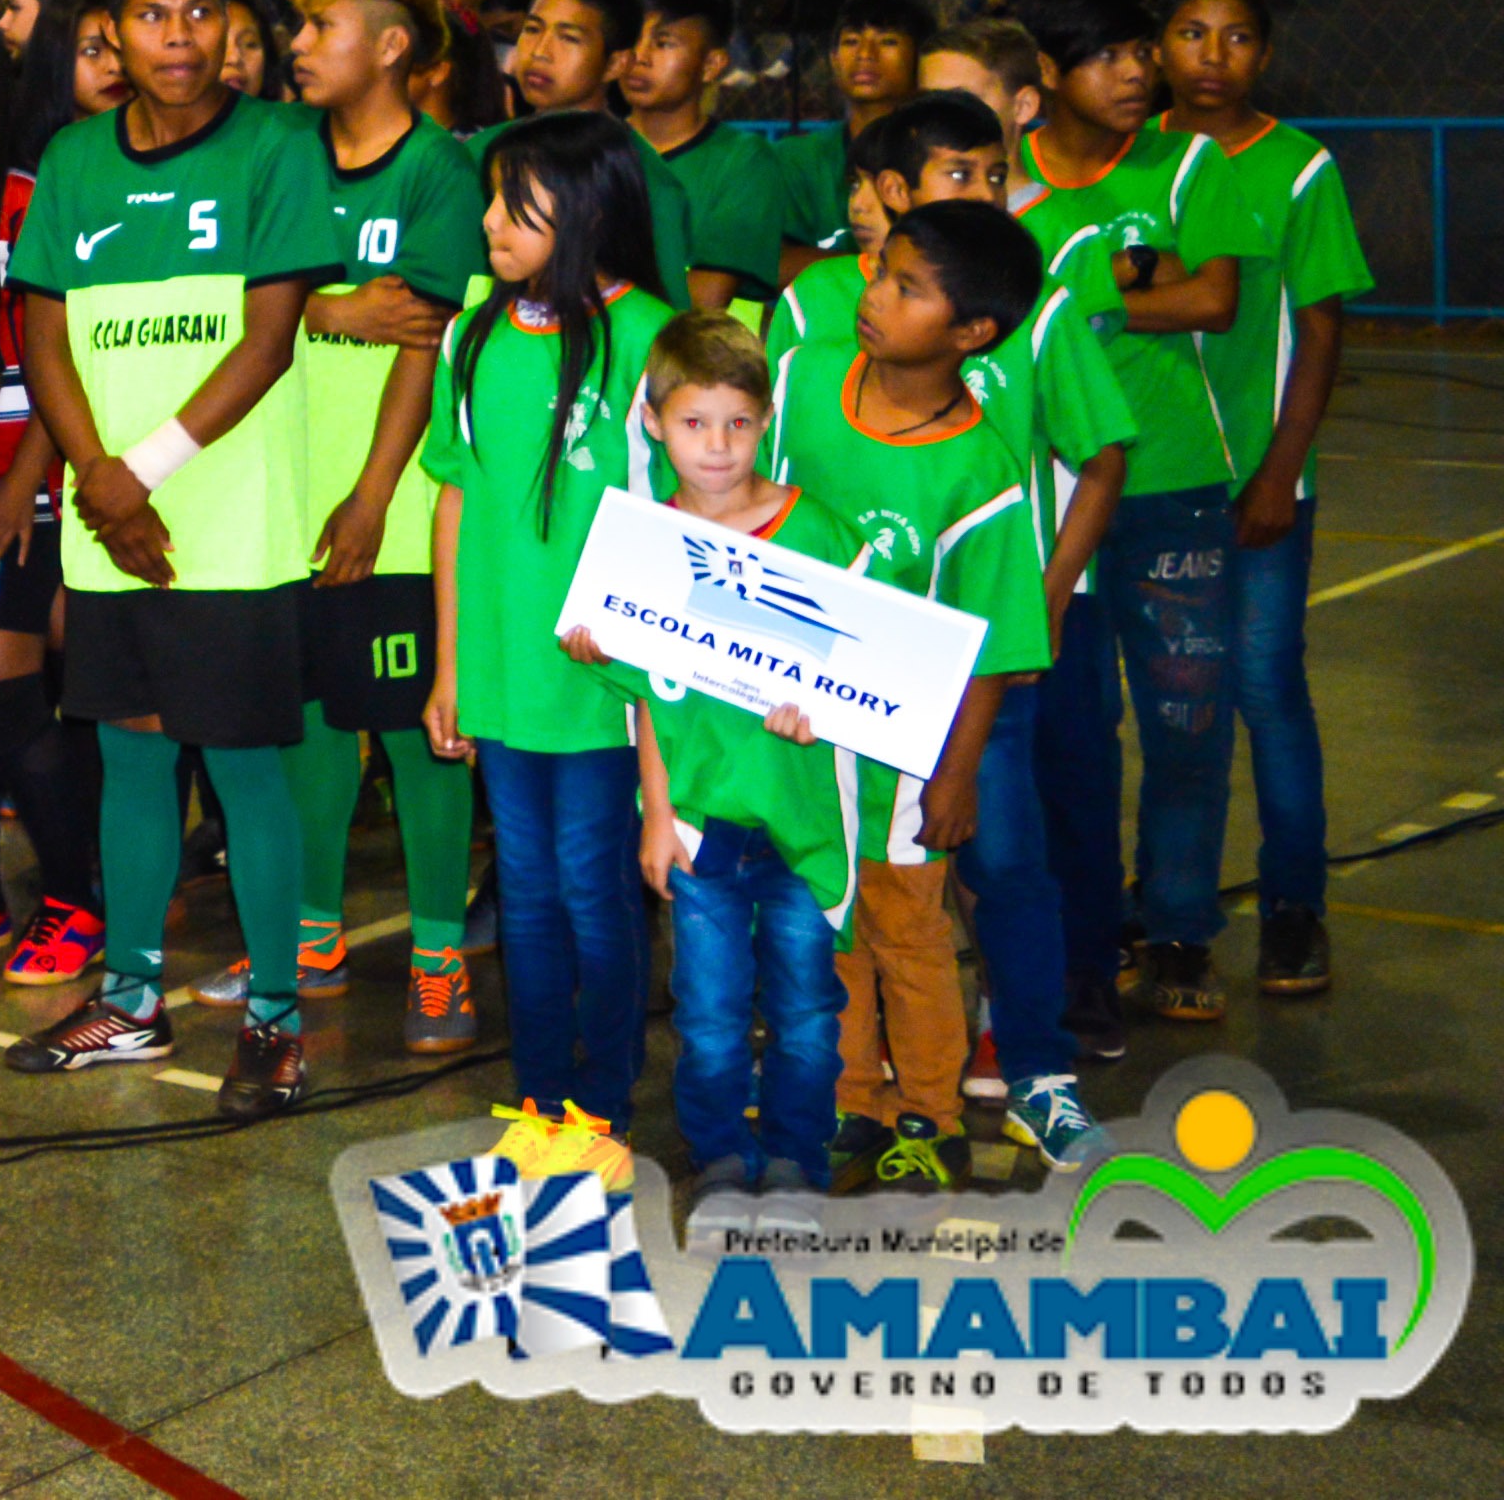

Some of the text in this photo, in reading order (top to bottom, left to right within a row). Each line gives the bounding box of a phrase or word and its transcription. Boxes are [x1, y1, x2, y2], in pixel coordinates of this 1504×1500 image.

[188, 200, 218, 250] 5
[358, 218, 398, 264] 10
[1147, 549, 1223, 580] JEANS
[373, 633, 417, 678] 10
[603, 594, 902, 717] ESCOLA MITÃ RORY
